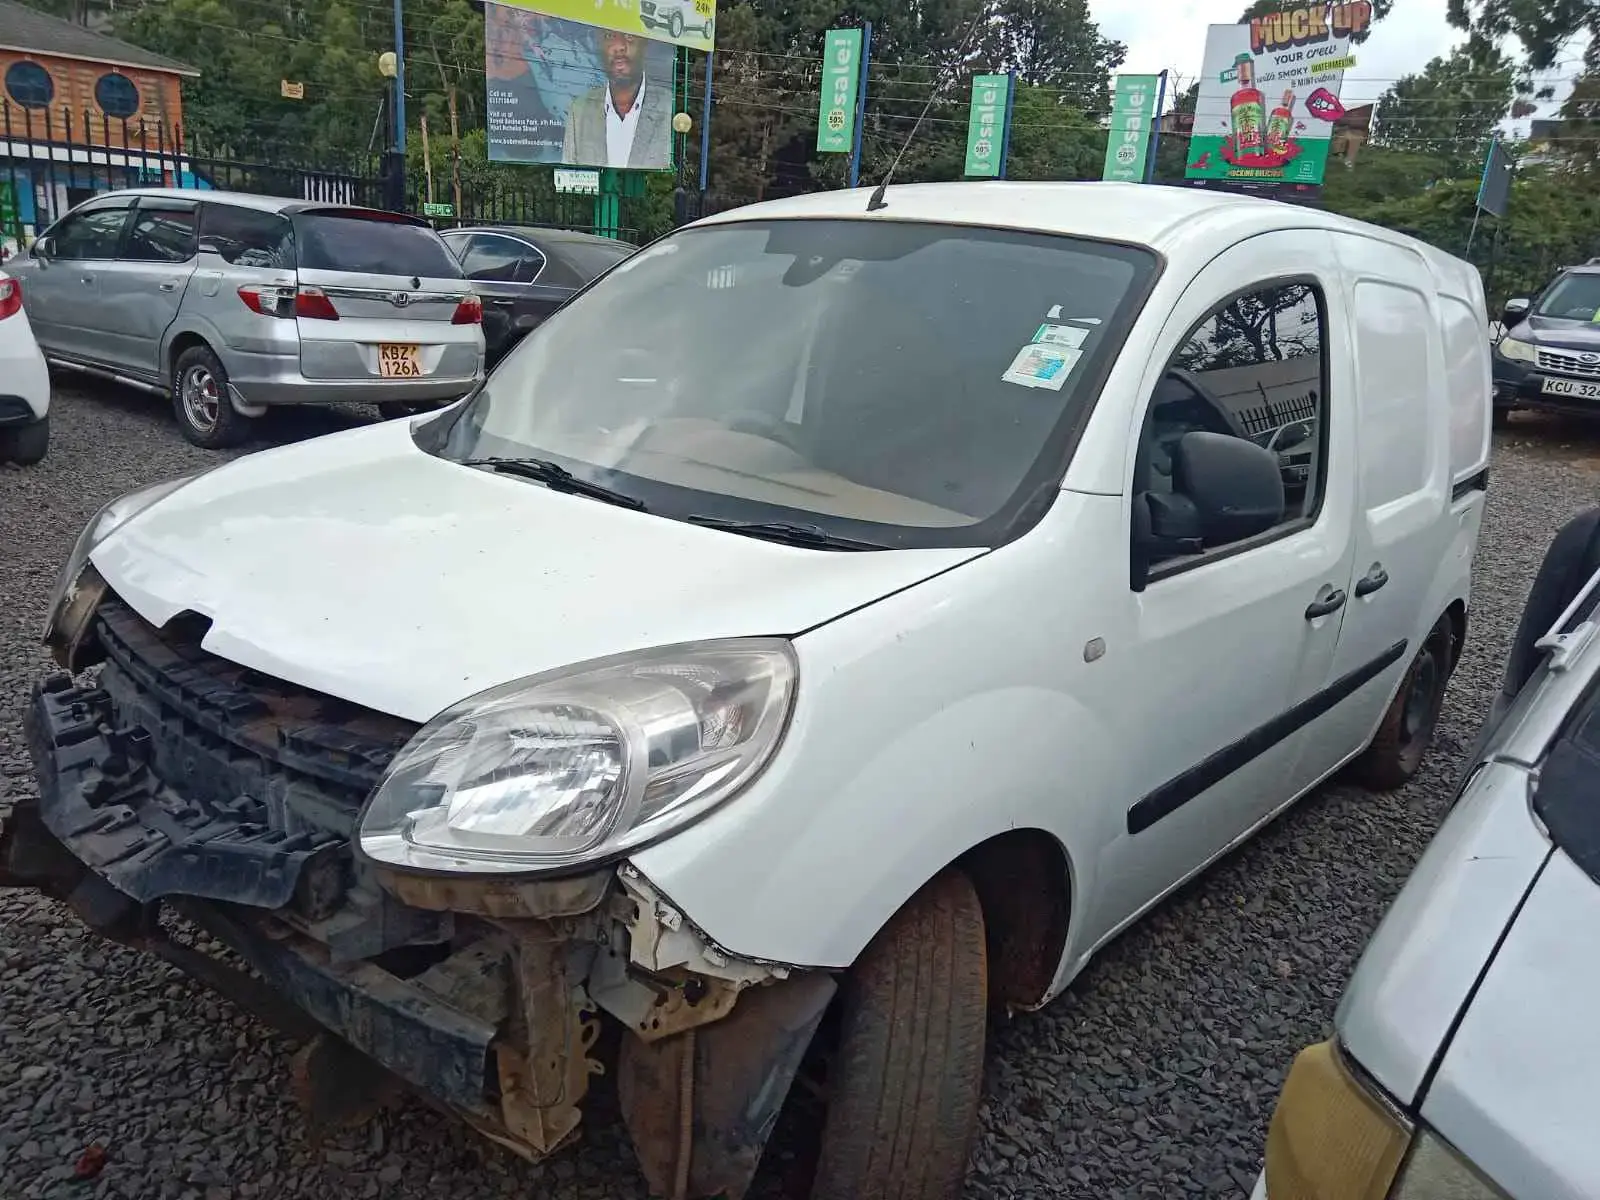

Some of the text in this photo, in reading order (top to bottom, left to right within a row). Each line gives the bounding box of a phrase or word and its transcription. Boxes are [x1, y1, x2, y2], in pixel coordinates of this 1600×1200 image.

[1250, 1, 1371, 53] MUCK UP
[1274, 44, 1337, 65] YOUR crew
[1278, 66, 1308, 79] SMOKY
[381, 345, 408, 360] KBZ
[385, 360, 420, 376] 126A
[1546, 380, 1573, 393] KCU
